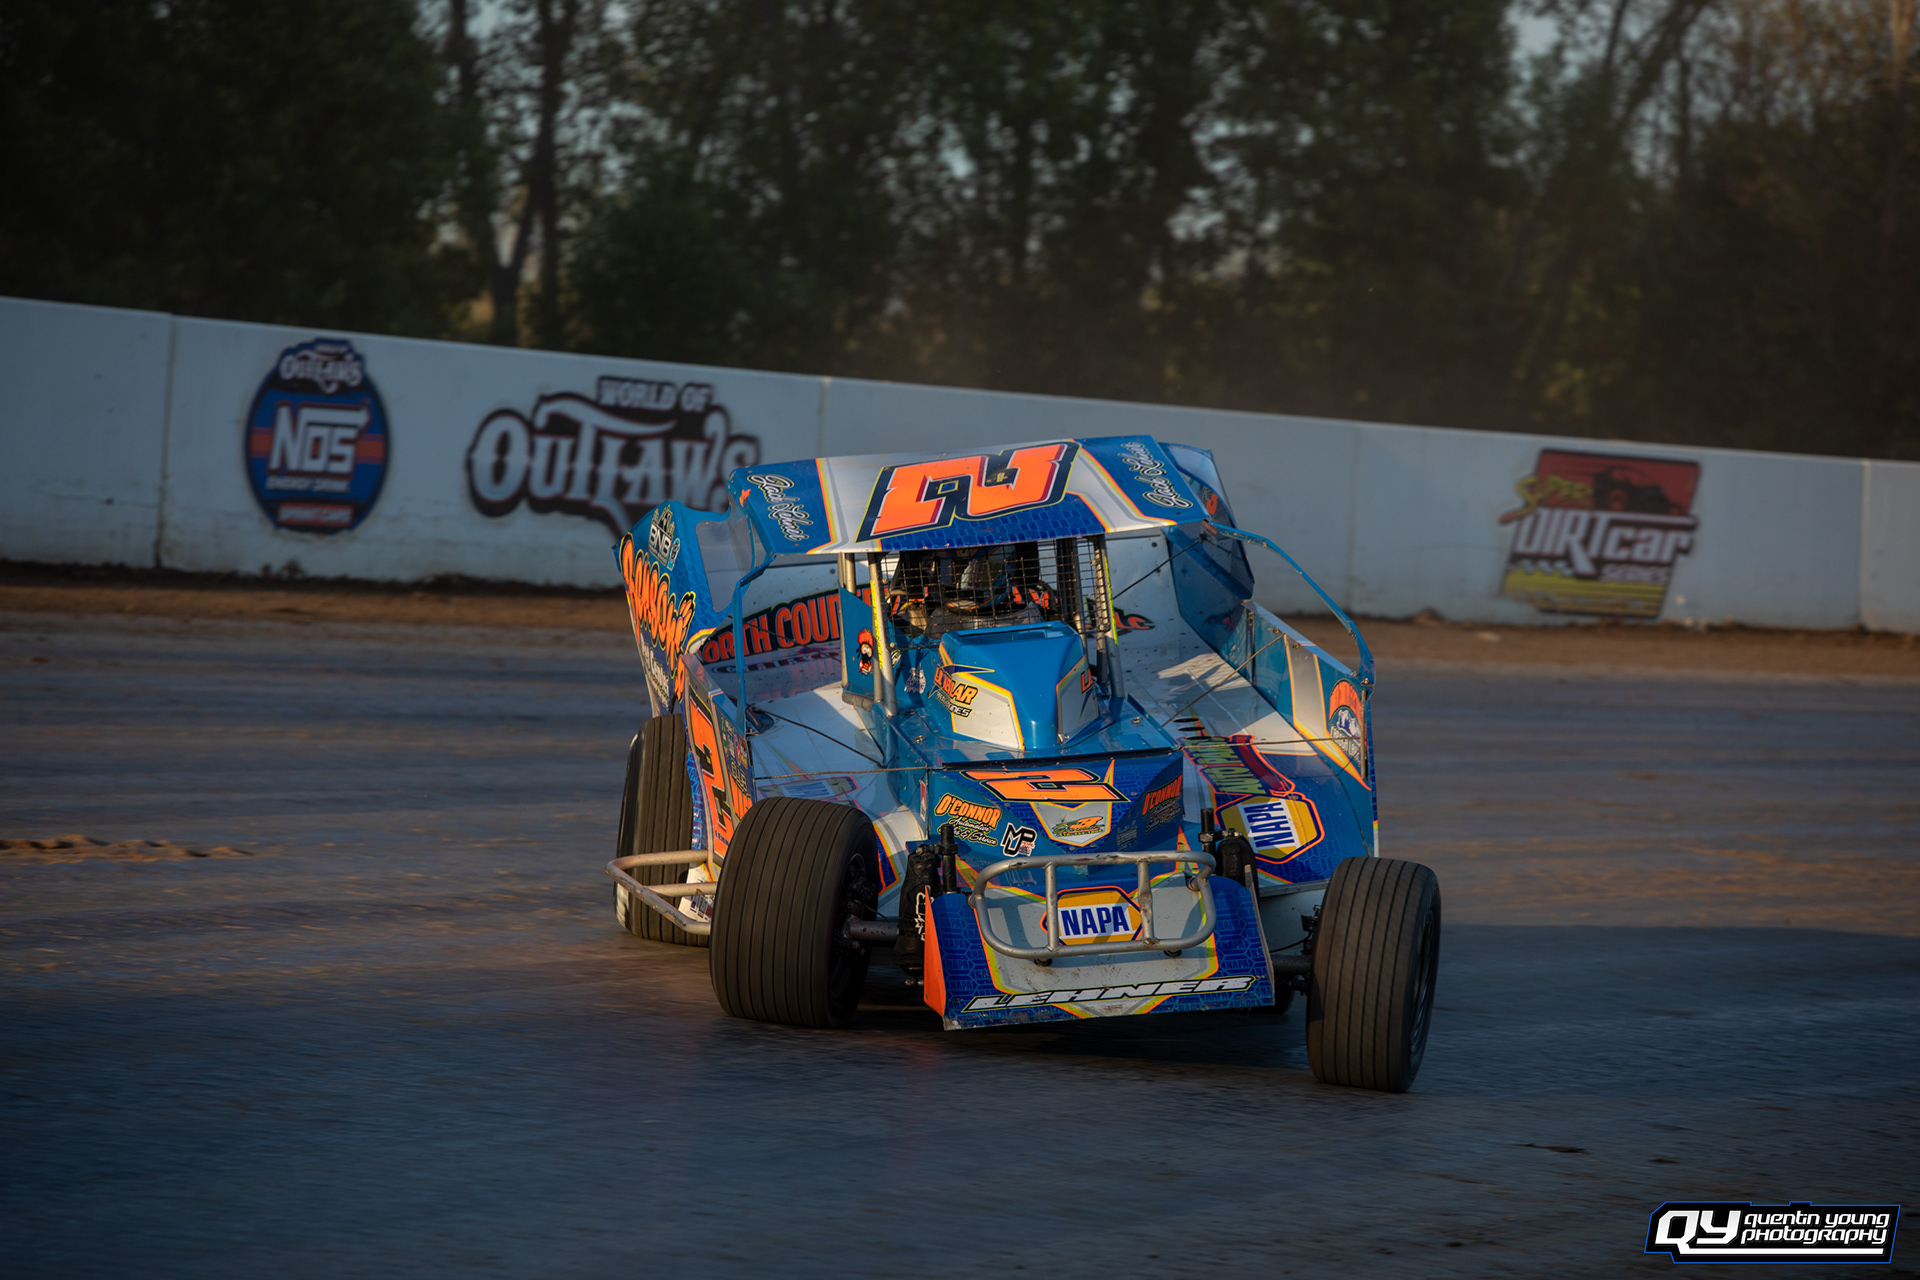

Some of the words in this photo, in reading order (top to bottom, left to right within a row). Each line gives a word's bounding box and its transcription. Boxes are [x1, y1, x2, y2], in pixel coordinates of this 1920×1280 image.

[598, 379, 676, 410] WORLD
[680, 384, 712, 412] OF
[269, 405, 371, 472] NOS
[649, 523, 671, 558] BNB
[1513, 508, 1697, 577] DIRTcar
[698, 614, 772, 665] ORTH
[935, 793, 1002, 829] O'CONNOR
[948, 816, 991, 833] Automotive
[1243, 802, 1295, 848] NAPA
[968, 831, 998, 846] Service
[1061, 905, 1133, 937] NAPA
[961, 976, 1255, 1012] LEHNER
